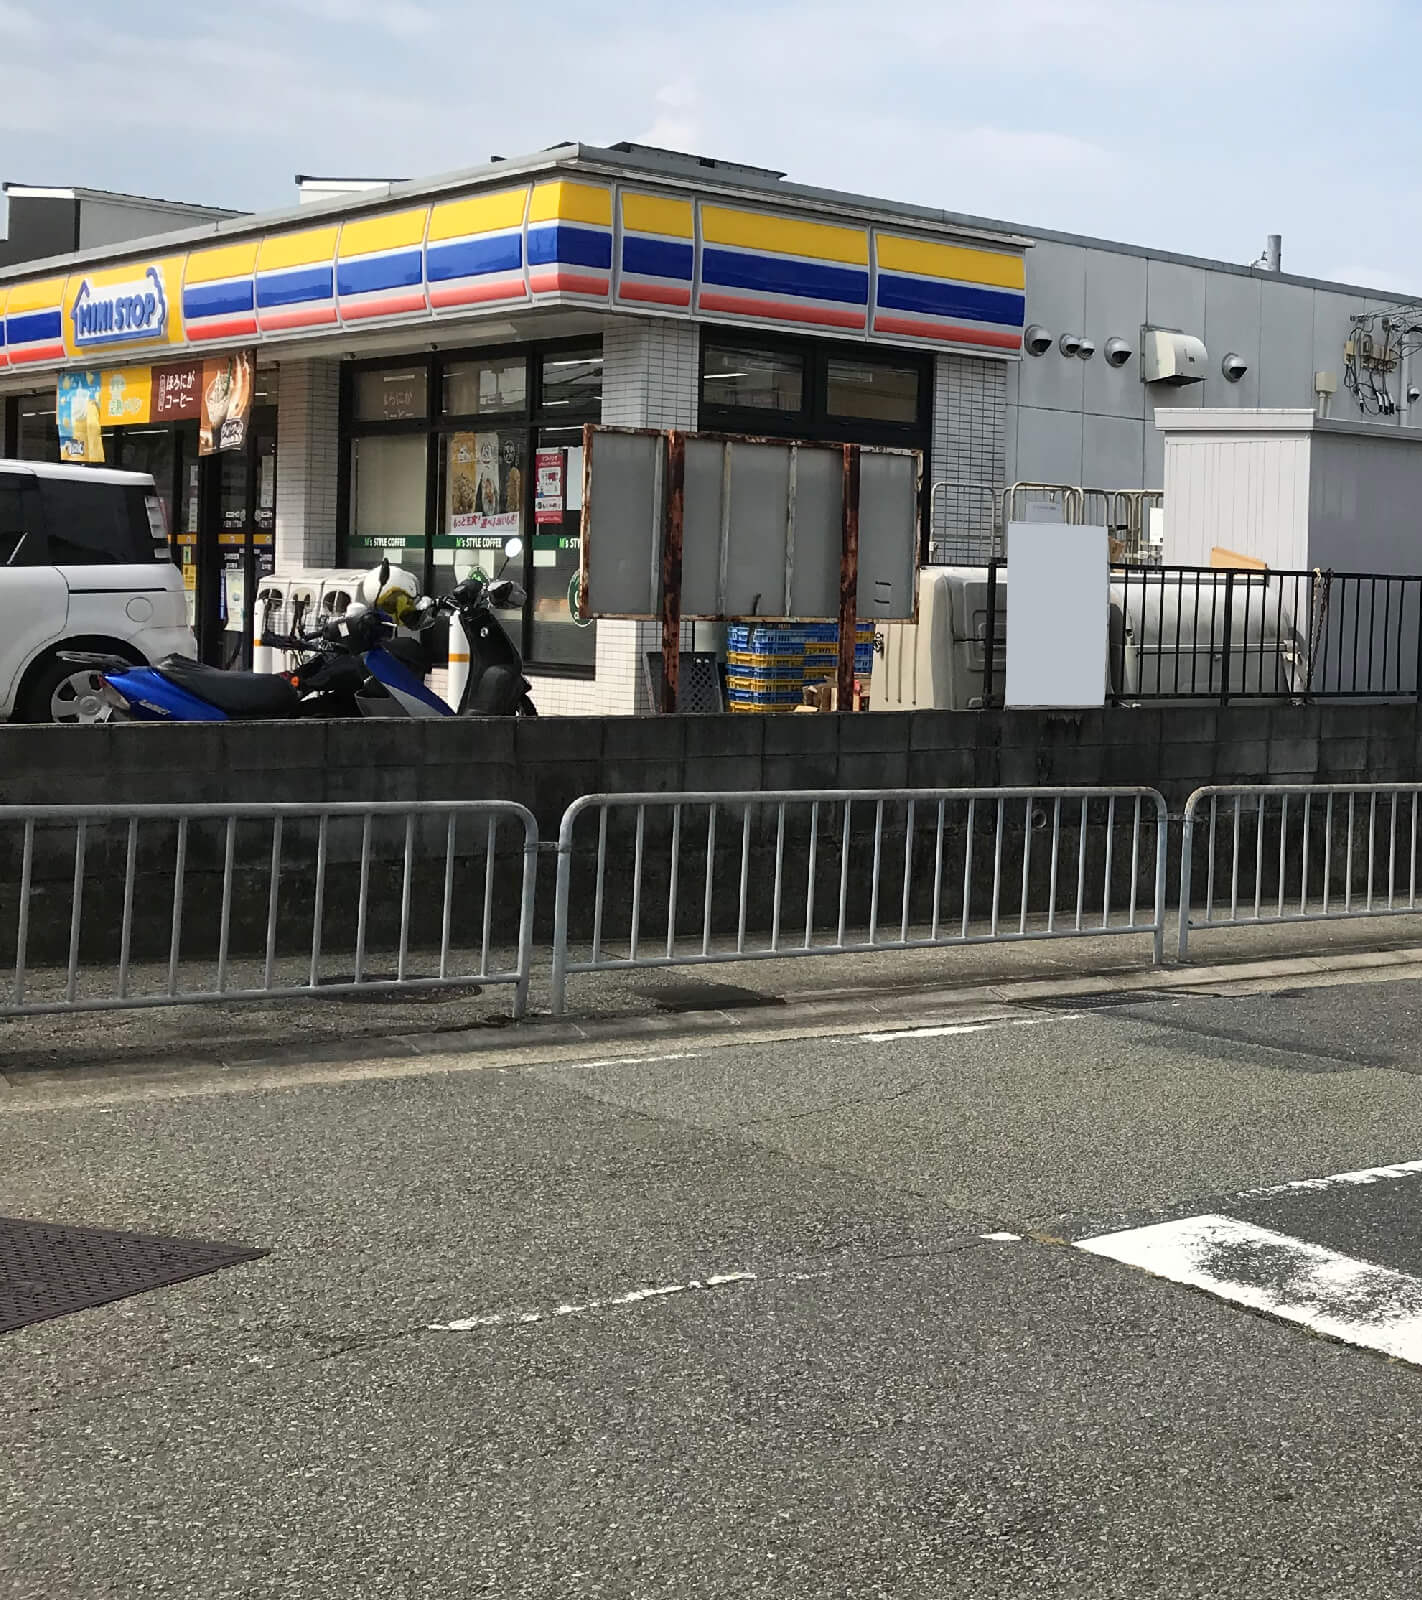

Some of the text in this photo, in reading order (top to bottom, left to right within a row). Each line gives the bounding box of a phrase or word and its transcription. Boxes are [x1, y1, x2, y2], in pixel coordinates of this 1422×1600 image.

[79, 292, 155, 335] MINI STOP
[166, 369, 195, 391] ほろにが
[165, 392, 194, 409] コーヒー
[373, 537, 388, 547] STYLE
[465, 537, 482, 548] STYLE
[482, 537, 502, 548] COFFEE
